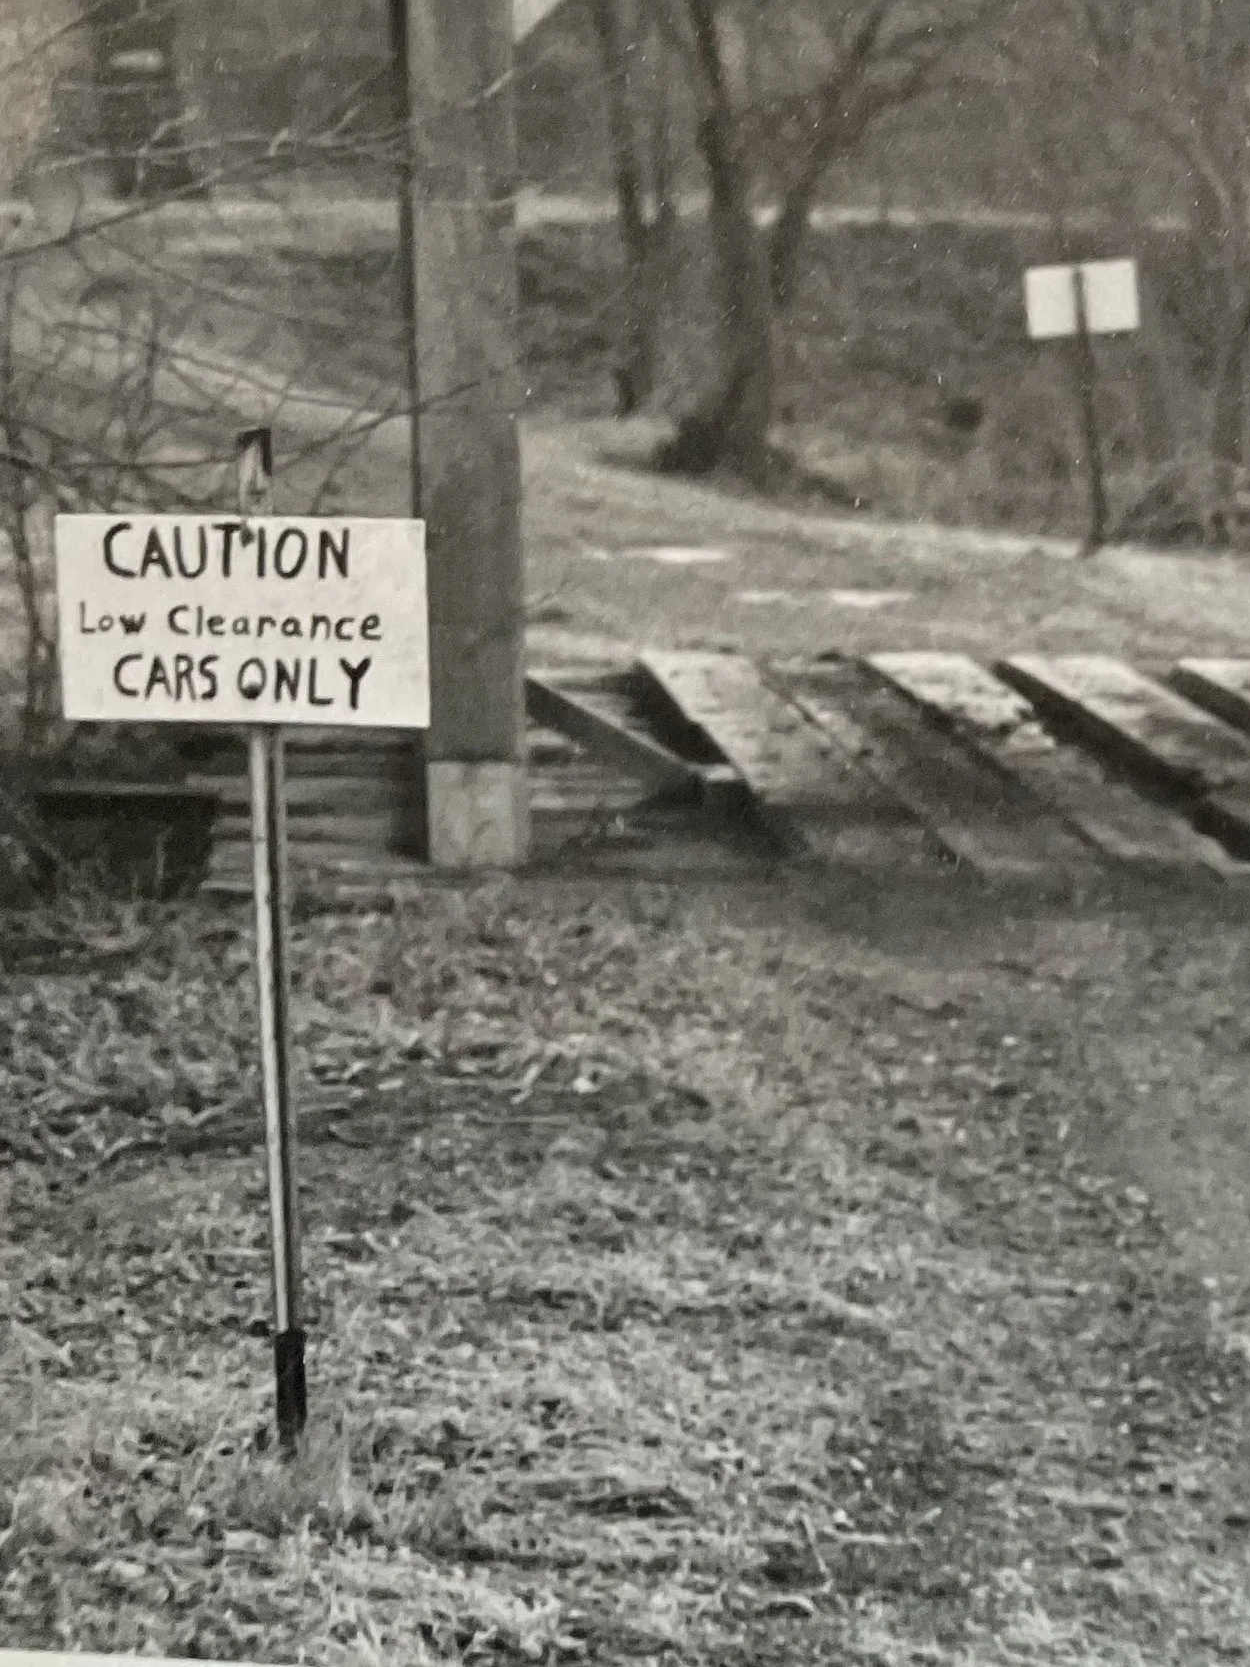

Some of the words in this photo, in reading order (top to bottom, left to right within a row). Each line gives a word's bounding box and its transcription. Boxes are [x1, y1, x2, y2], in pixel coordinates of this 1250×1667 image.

[103, 521, 350, 579] CAUTION
[79, 601, 147, 634] Low
[167, 604, 382, 642] Clearance
[113, 653, 220, 701] CARS
[237, 656, 372, 710] ONLY
